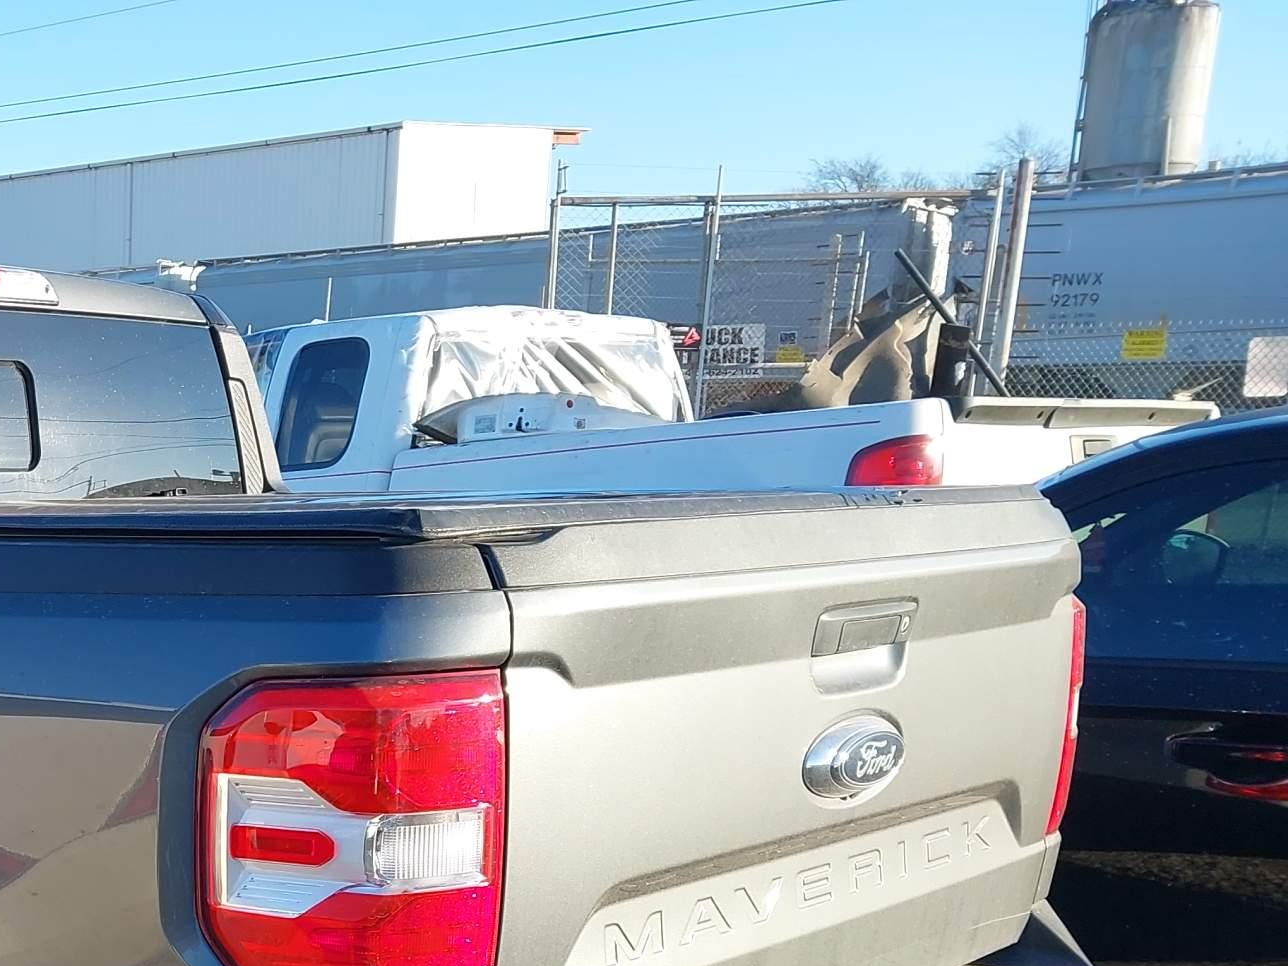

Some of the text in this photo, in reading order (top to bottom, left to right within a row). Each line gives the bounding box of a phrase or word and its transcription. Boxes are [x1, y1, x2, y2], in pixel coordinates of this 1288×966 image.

[1051, 271, 1103, 287] PNWX
[1050, 291, 1100, 307] 92179
[855, 739, 898, 779] Ford
